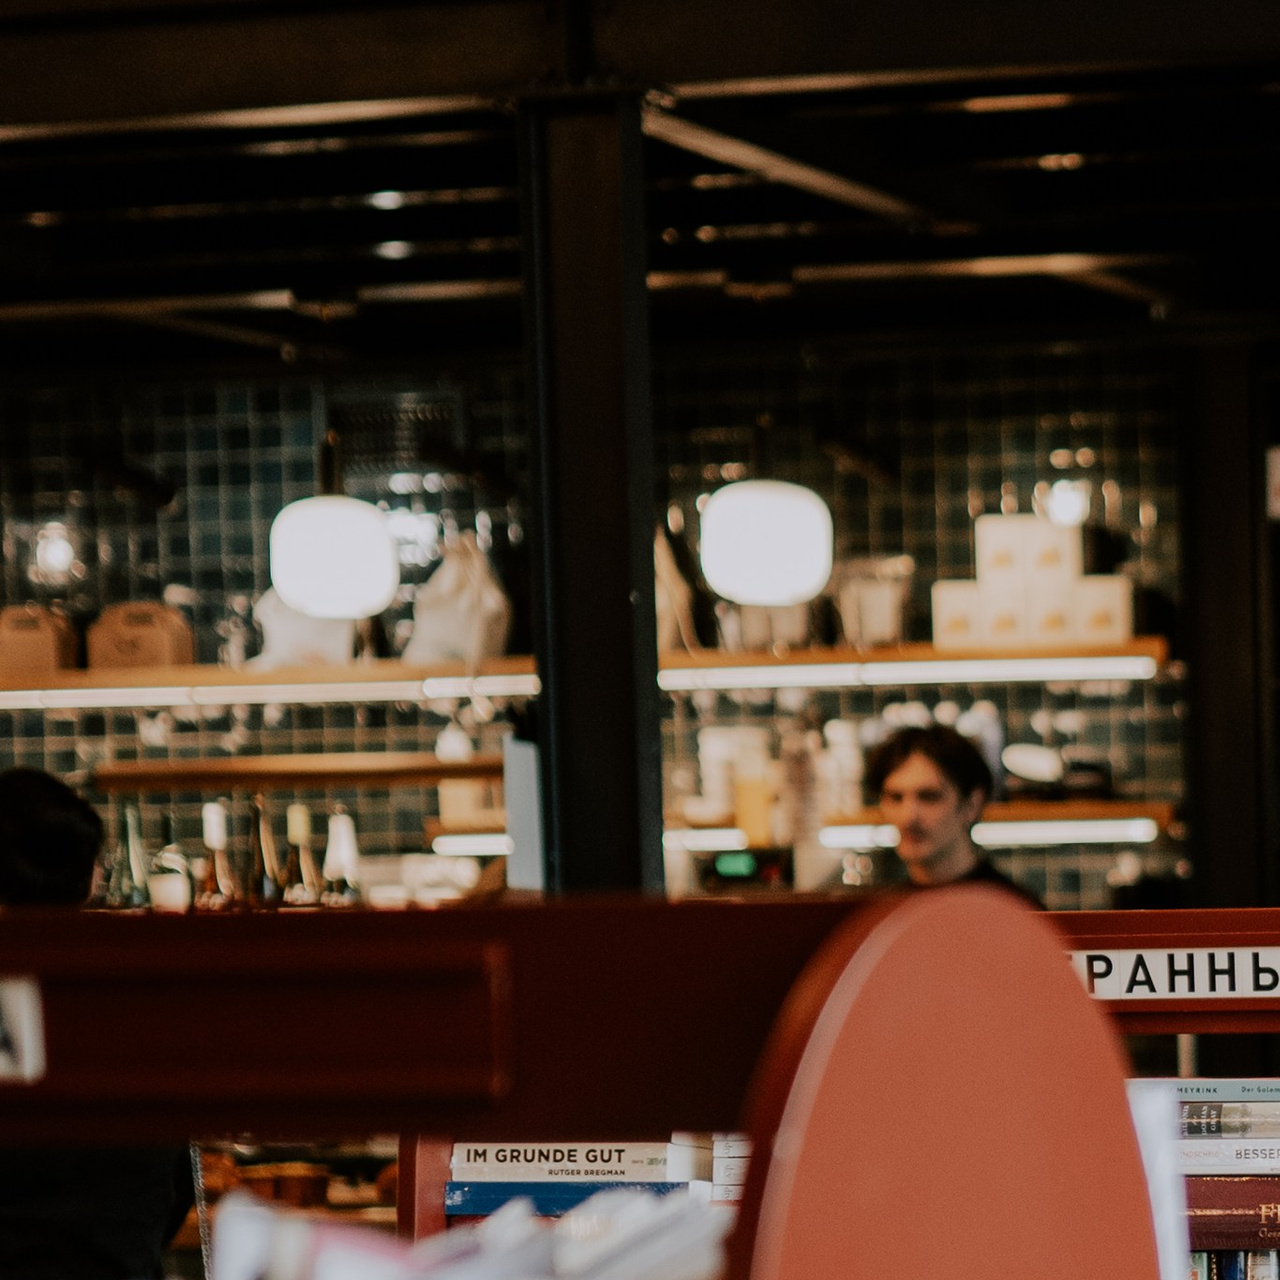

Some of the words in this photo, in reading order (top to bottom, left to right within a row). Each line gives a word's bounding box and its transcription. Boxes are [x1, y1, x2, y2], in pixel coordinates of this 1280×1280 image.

[467, 1149, 487, 1163] IM
[495, 1149, 577, 1163] GRUNDE
[586, 1149, 625, 1163] GUT
